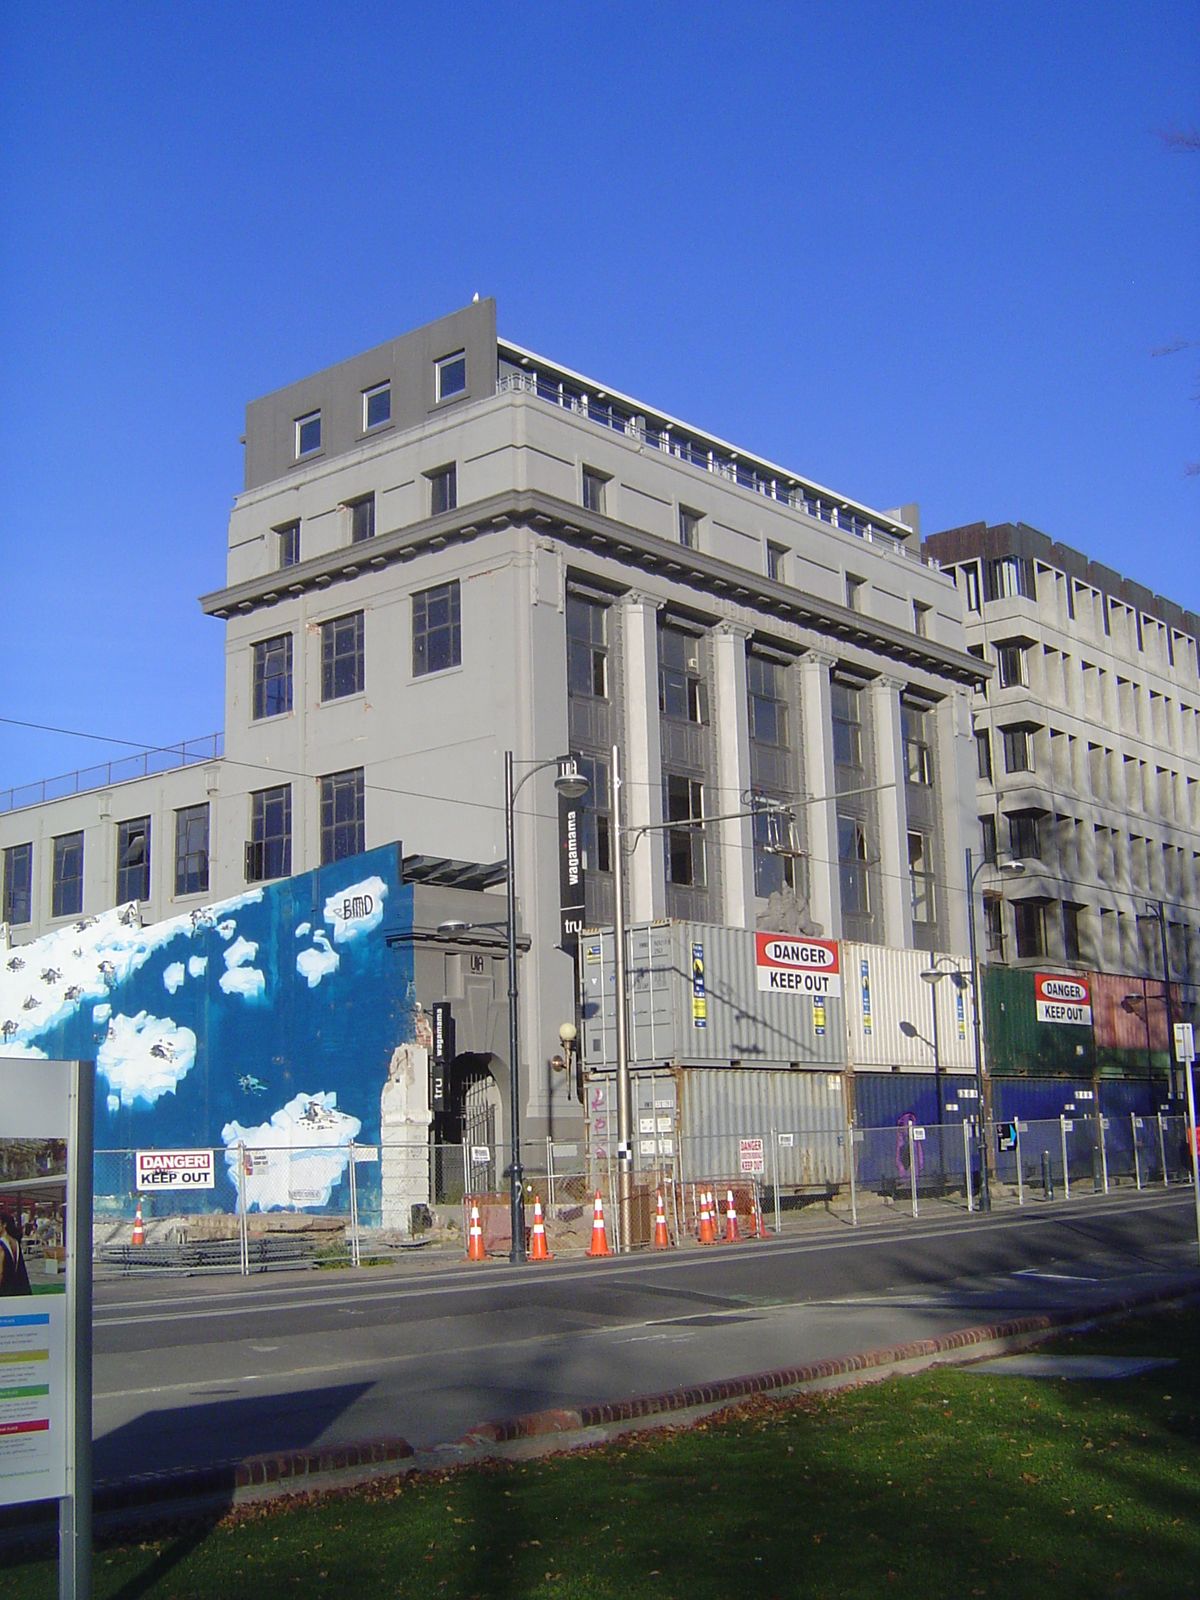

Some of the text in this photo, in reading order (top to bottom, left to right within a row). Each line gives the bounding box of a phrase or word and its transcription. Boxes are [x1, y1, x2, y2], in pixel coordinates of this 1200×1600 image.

[567, 811, 580, 886] wagamama
[565, 919, 582, 933] tru
[773, 943, 827, 964] DANGER
[770, 971, 830, 992] KEEP OUT
[1046, 982, 1082, 998] DANGER
[1044, 1004, 1083, 1021] KEEP OUT
[434, 1077, 443, 1099] tru
[740, 1140, 762, 1151] DANGER
[142, 1155, 209, 1169] DANGER!
[742, 1160, 753, 1170] KEEP
[141, 1172, 210, 1184] KEEP OUT
